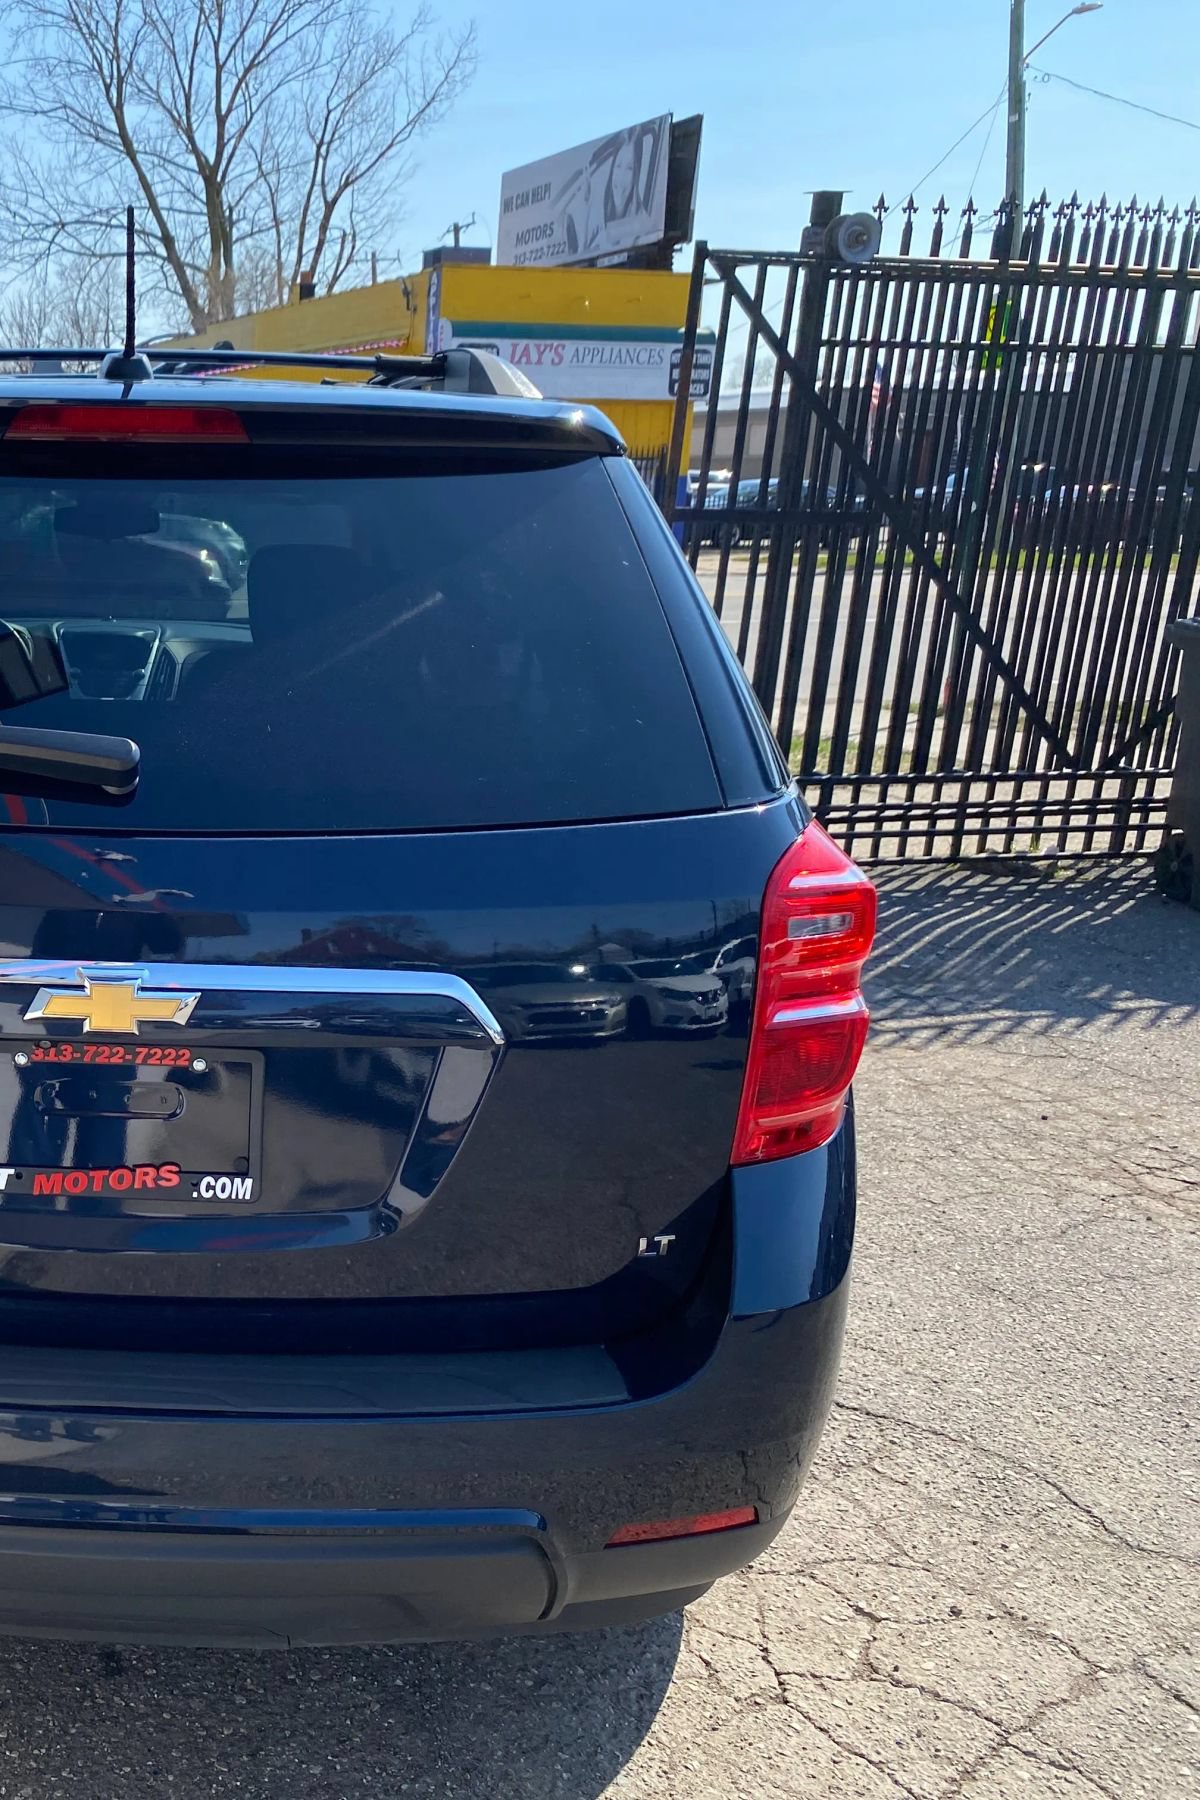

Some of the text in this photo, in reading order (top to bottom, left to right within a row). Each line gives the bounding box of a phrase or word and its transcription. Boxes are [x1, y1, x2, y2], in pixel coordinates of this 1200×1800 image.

[515, 188, 530, 211] CAN
[515, 221, 555, 248] MOTORS
[513, 240, 567, 266] 313-722-7222
[569, 345, 665, 367] APPLIANCES
[31, 1043, 191, 1066] 313-722-7222
[32, 1164, 181, 1196] MOTORS
[191, 1175, 253, 1200] .COM
[637, 1234, 676, 1257] LT
